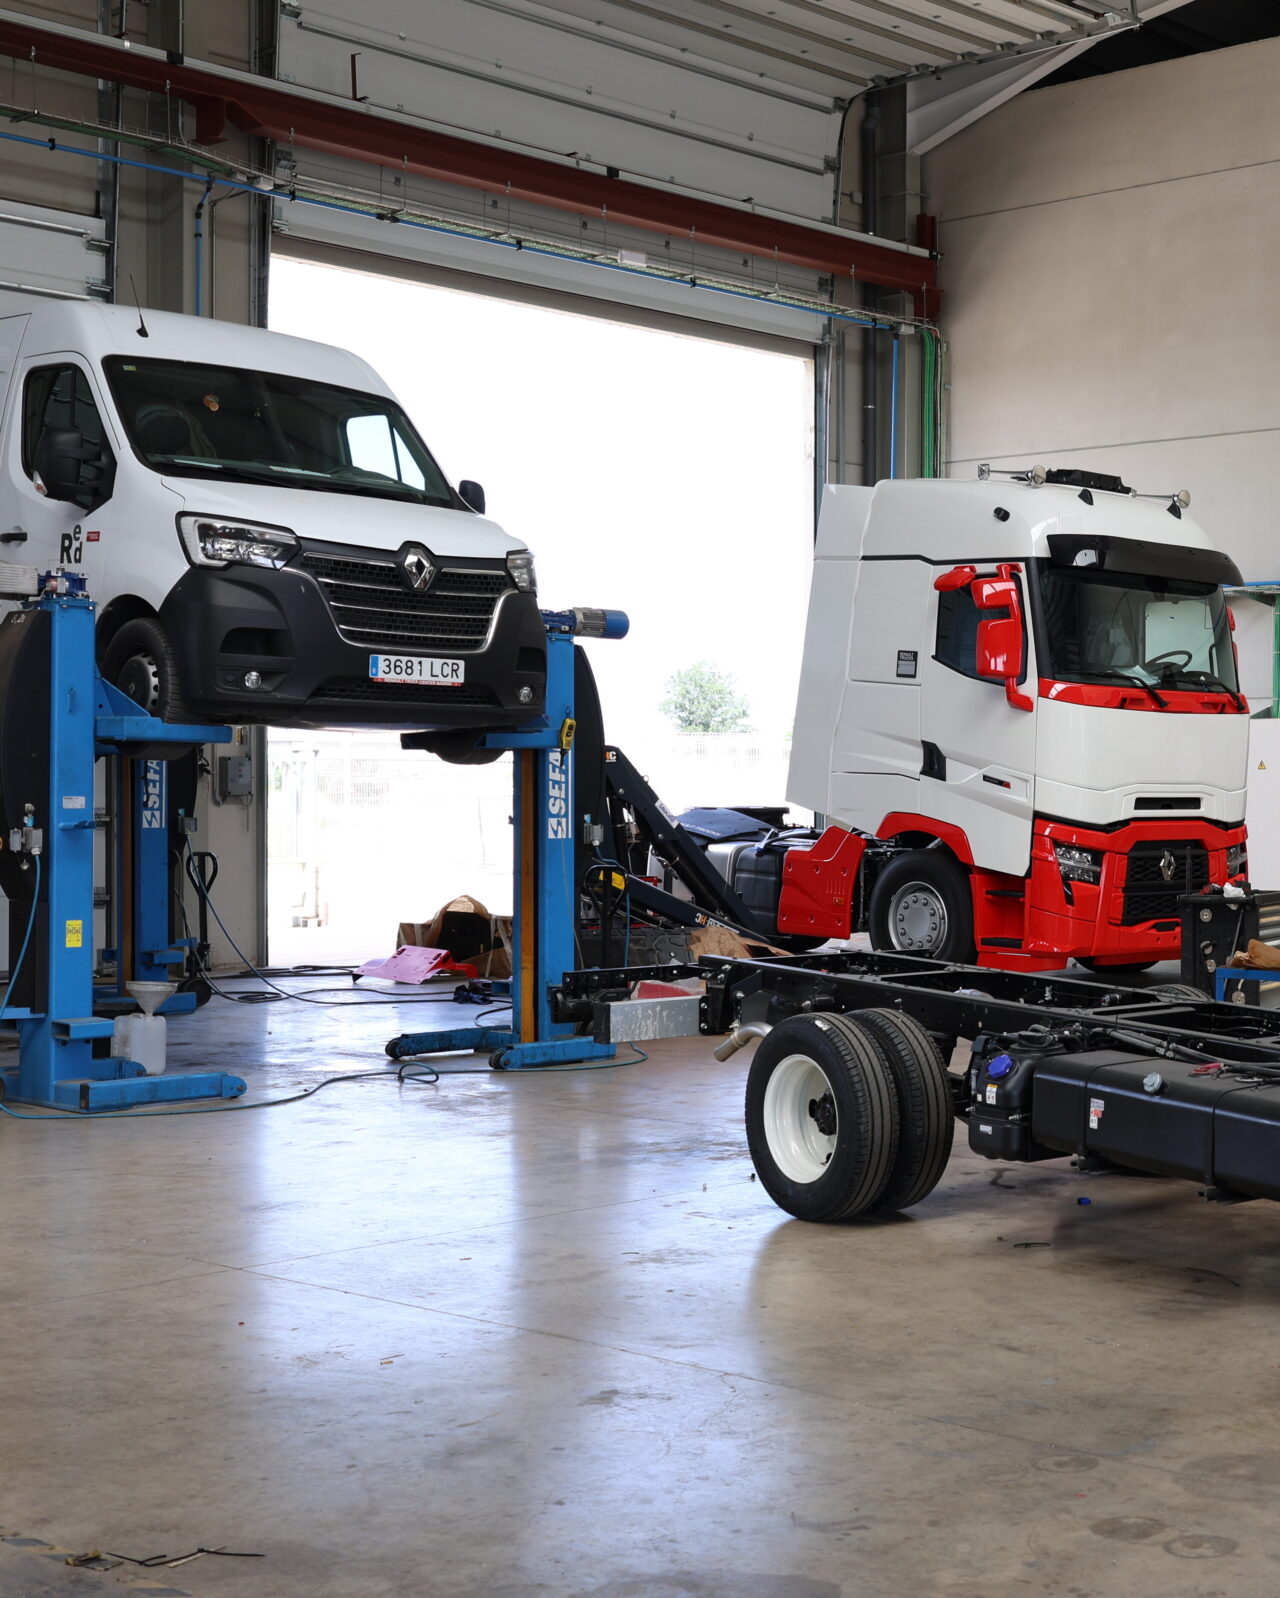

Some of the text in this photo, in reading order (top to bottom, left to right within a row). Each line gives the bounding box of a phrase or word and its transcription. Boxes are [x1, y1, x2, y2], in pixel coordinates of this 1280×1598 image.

[382, 658, 460, 679] 3681 LCR
[144, 760, 160, 809] SEFA
[548, 748, 566, 816] SEFA
